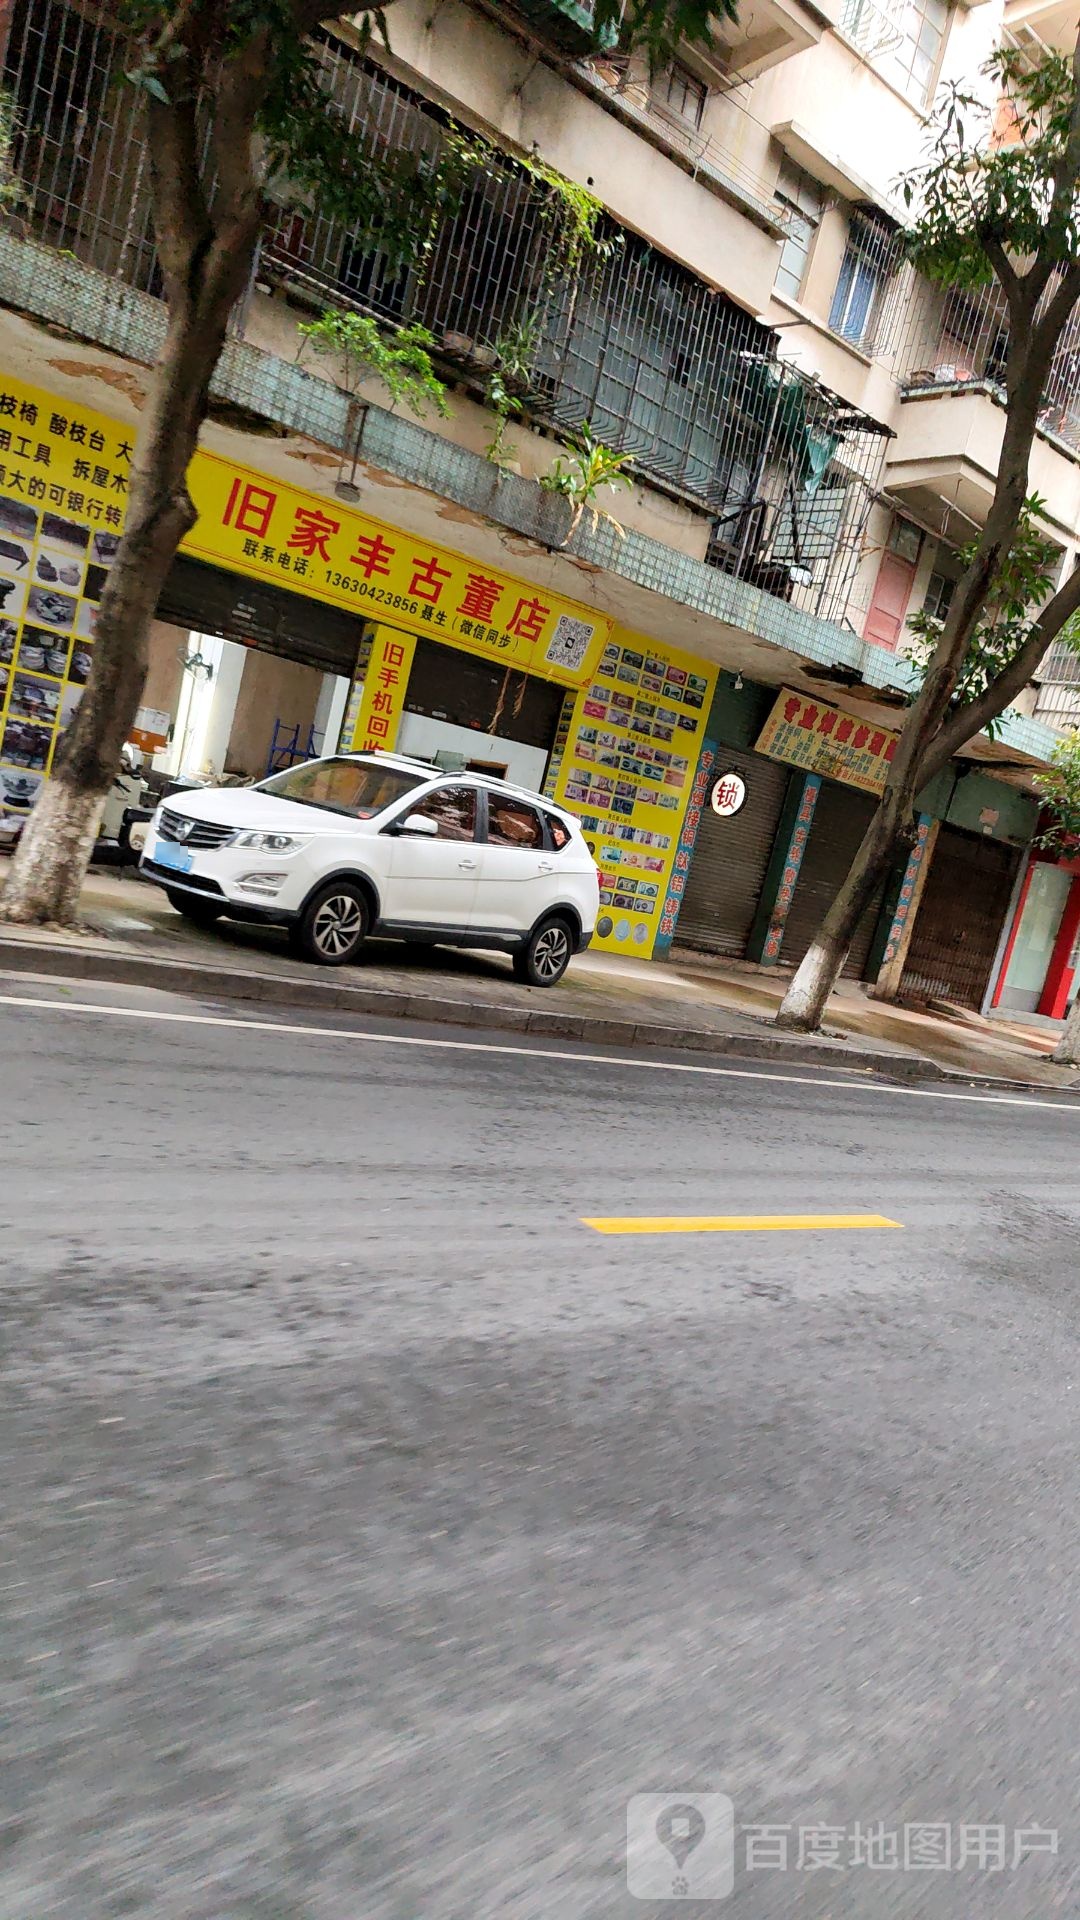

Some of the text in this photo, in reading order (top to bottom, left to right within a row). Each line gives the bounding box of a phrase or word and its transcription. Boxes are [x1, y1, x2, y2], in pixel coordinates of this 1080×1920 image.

[49, 412, 106, 452] 酸枝台
[72, 458, 129, 493] 拆屋木
[221, 477, 551, 643] 旧家丰古董店
[716, 780, 741, 811] 锁
